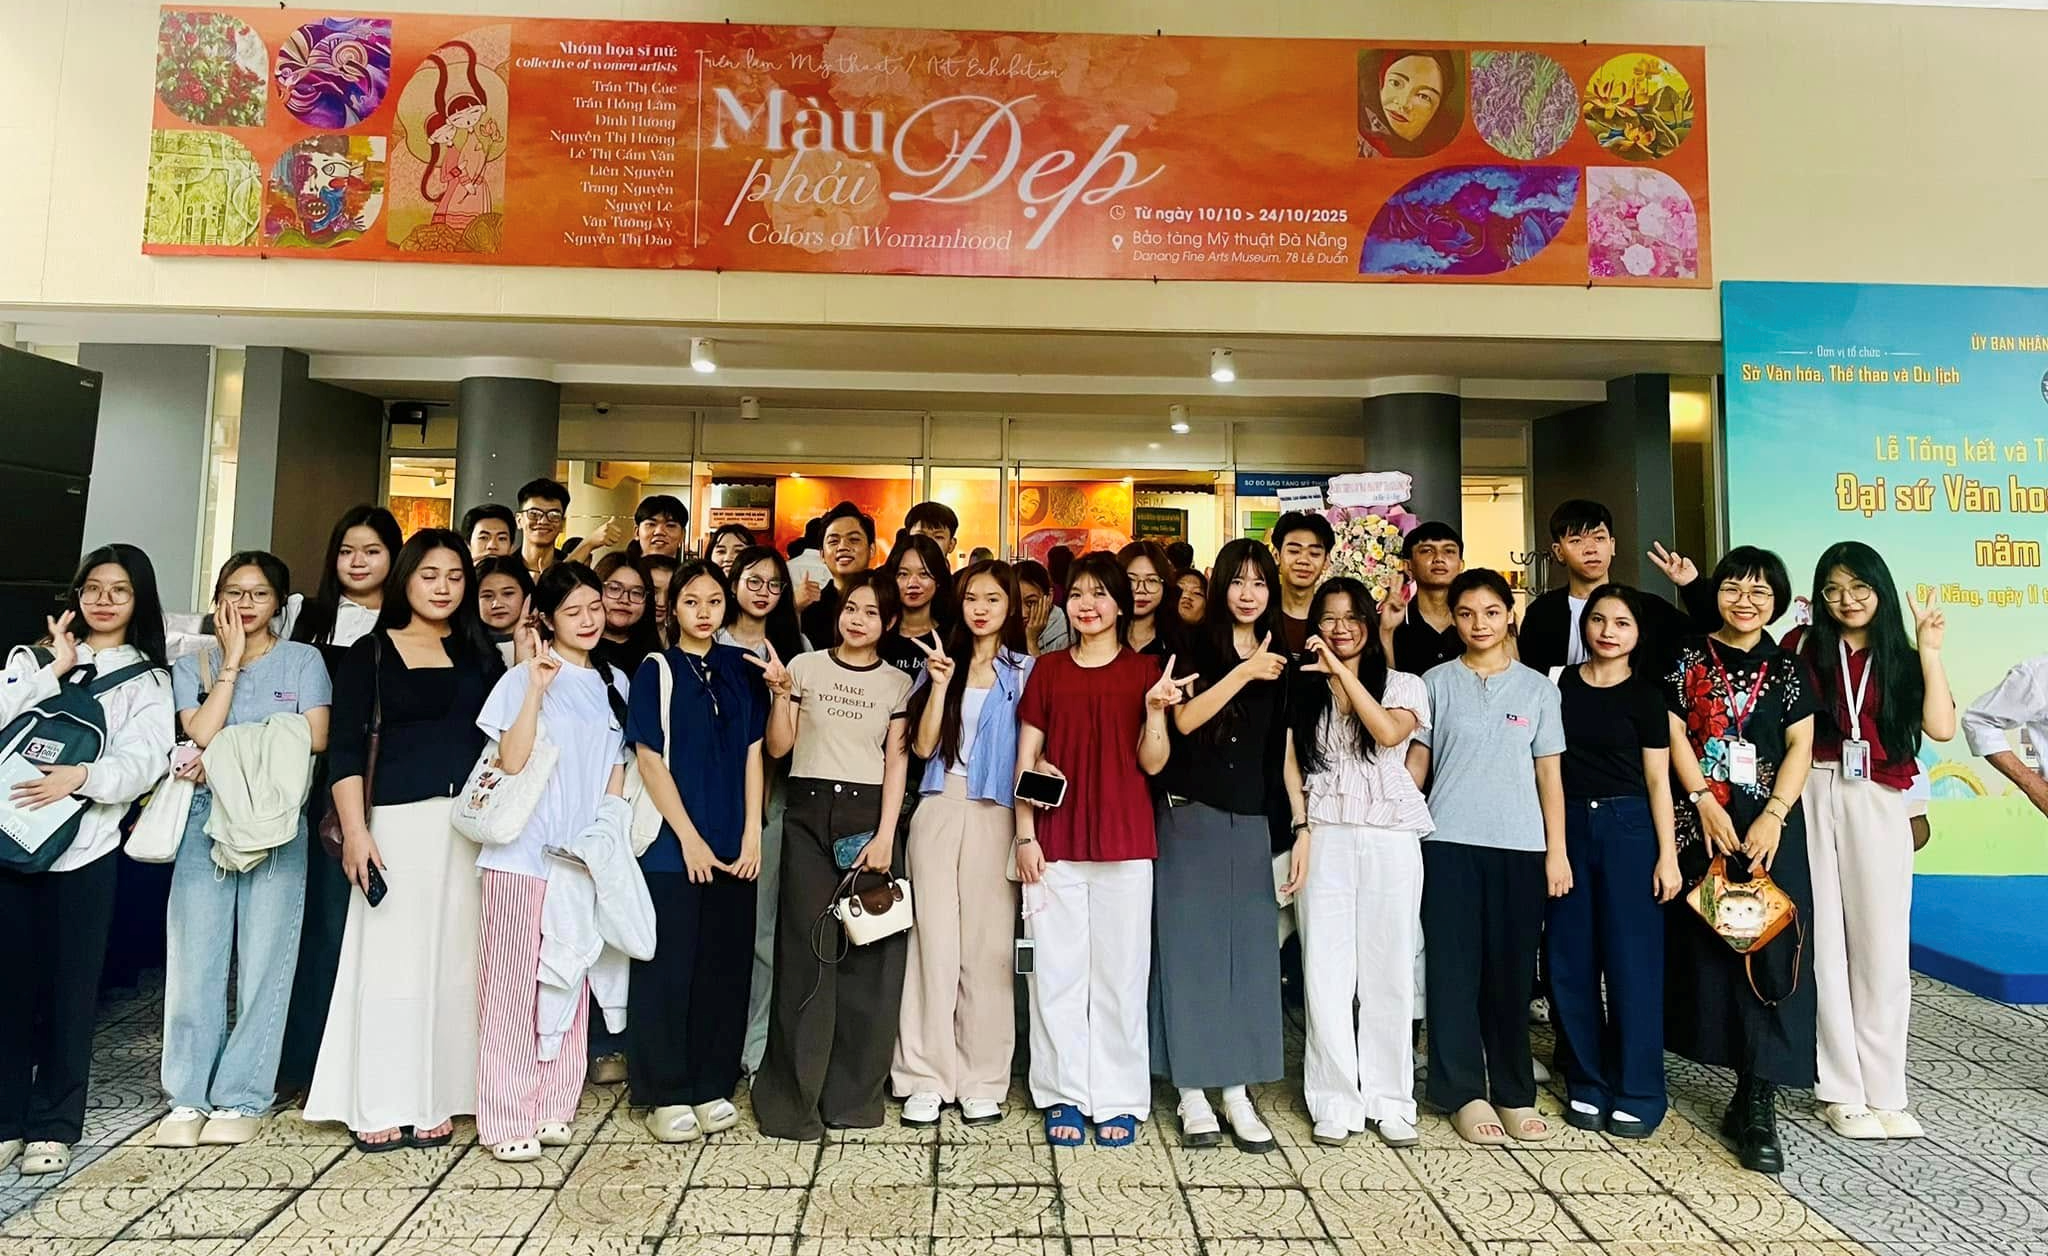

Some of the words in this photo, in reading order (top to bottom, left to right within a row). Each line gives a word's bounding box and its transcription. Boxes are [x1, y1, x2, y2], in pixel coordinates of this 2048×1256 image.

[560, 41, 602, 55] Nhóm
[606, 42, 634, 58] họa
[515, 57, 575, 70] Collective
[576, 58, 592, 71] of
[593, 61, 638, 72] women
[639, 61, 678, 73] artists
[927, 55, 966, 77] Art
[966, 53, 1064, 79] Exhibition
[626, 81, 647, 95] Thị
[648, 98, 676, 111] Lâm
[605, 131, 627, 145] Thị
[570, 147, 586, 159] Lê
[590, 147, 611, 161] Thị
[590, 164, 619, 177] Liên
[711, 87, 885, 155] Màu
[889, 94, 1166, 249] Đẹp
[580, 181, 618, 196] Trang
[723, 147, 878, 227] phải
[657, 200, 672, 212] Lê
[1134, 206, 1153, 220] Từ
[1155, 207, 1193, 223] ngày
[1199, 208, 1241, 222] 10/10
[1246, 211, 1255, 220] >
[1258, 208, 1348, 223] 24/10/2025
[619, 233, 641, 248] Thị
[747, 222, 825, 246] Colors
[830, 224, 860, 248] of
[861, 225, 1014, 251] Womanhood
[1133, 230, 1162, 245] Bảo
[1167, 231, 1202, 250] tàng
[1207, 231, 1230, 249] Mỹ
[1233, 231, 1275, 249] thuật
[1279, 231, 1301, 246] Đà
[1306, 231, 1348, 250] Nẵng
[1133, 251, 1180, 264] Danang
[1182, 251, 1205, 263] Fine
[1207, 251, 1229, 263] Arts
[1286, 252, 1299, 264] 78
[1301, 252, 1315, 264] Lê
[1991, 336, 2015, 352] BAN
[1766, 364, 1792, 382] Văn
[1796, 365, 1825, 384] hóa,
[1828, 364, 1854, 382] Thể
[1858, 365, 1889, 383] thao
[1893, 367, 1909, 383] và
[1935, 366, 1960, 387] lịch
[1875, 435, 1900, 461] Lễ
[1906, 435, 1958, 467] Tổng
[1964, 435, 1997, 463] kết
[2004, 440, 2028, 463] và
[1835, 472, 1887, 518] Đại
[1895, 478, 1936, 513] sứ
[1943, 474, 2001, 513] Văn
[2008, 474, 2048, 514] ho
[1975, 534, 2041, 567] năm
[1987, 586, 2023, 607] ngày
[833, 682, 864, 697] MAKE
[818, 693, 876, 709] YOURSELF
[827, 707, 863, 720] GOOD
